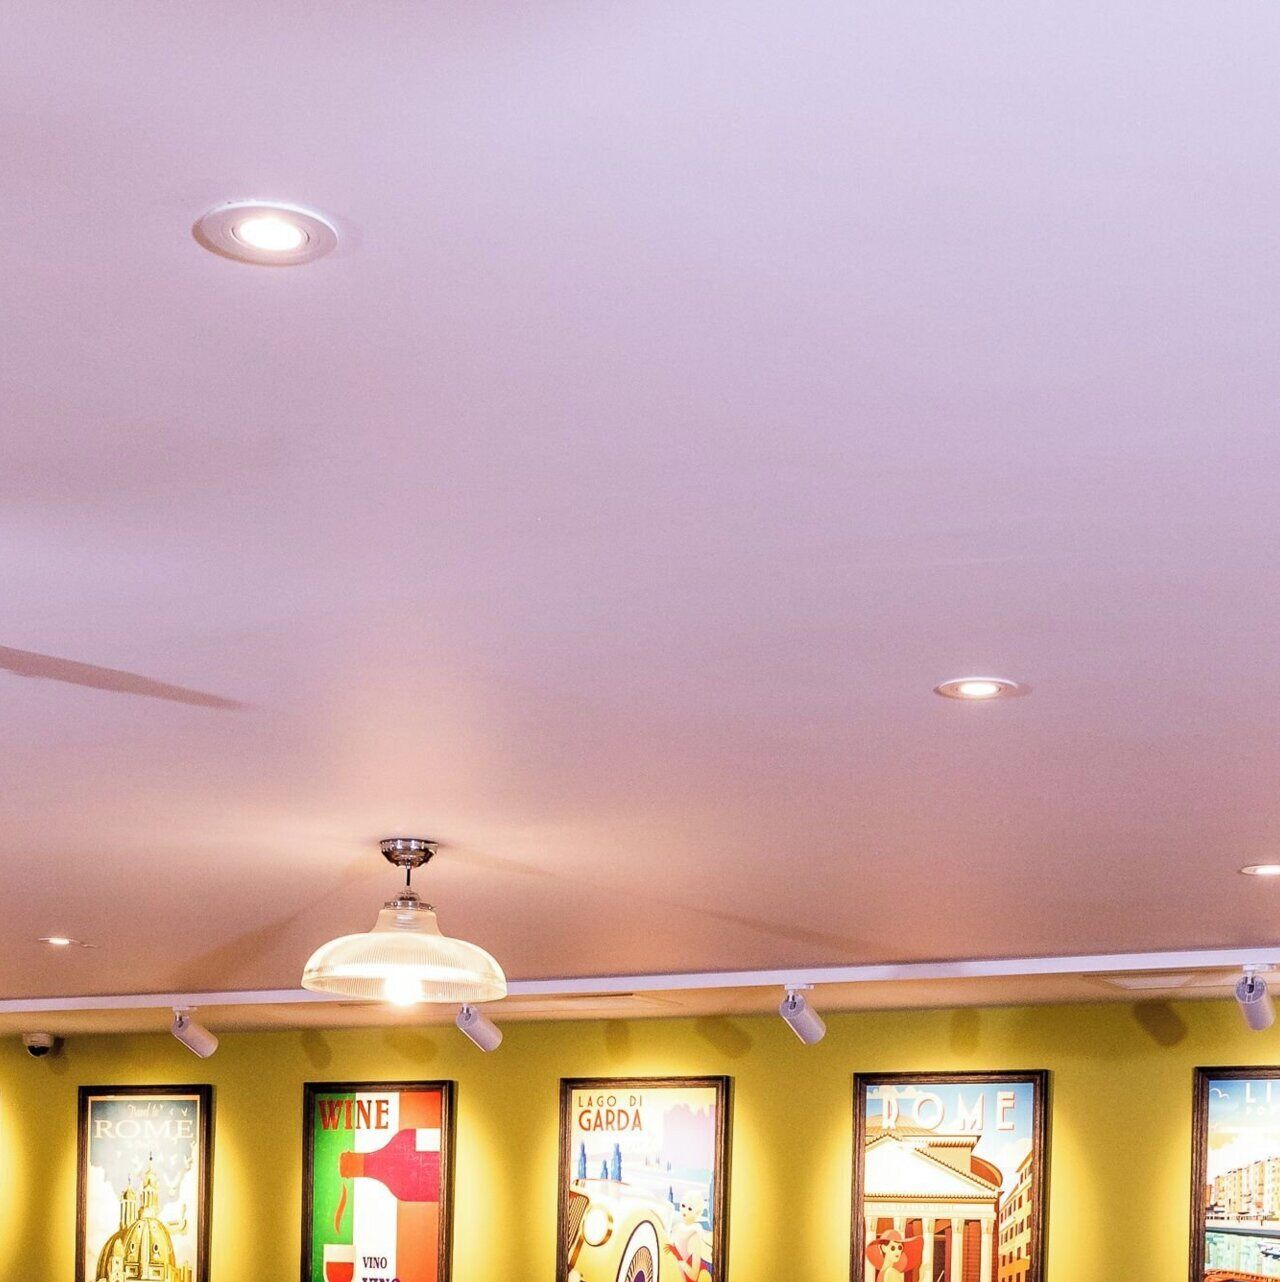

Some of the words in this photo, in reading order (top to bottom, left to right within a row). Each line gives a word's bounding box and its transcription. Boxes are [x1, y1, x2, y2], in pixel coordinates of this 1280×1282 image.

[578, 1095, 616, 1107] LAGO
[629, 1095, 642, 1107] DI
[882, 1089, 1016, 1132] ROME
[318, 1099, 389, 1130] WINE
[578, 1109, 642, 1131] GARDA
[94, 1119, 194, 1139] ROME
[362, 1256, 387, 1269] VINO
